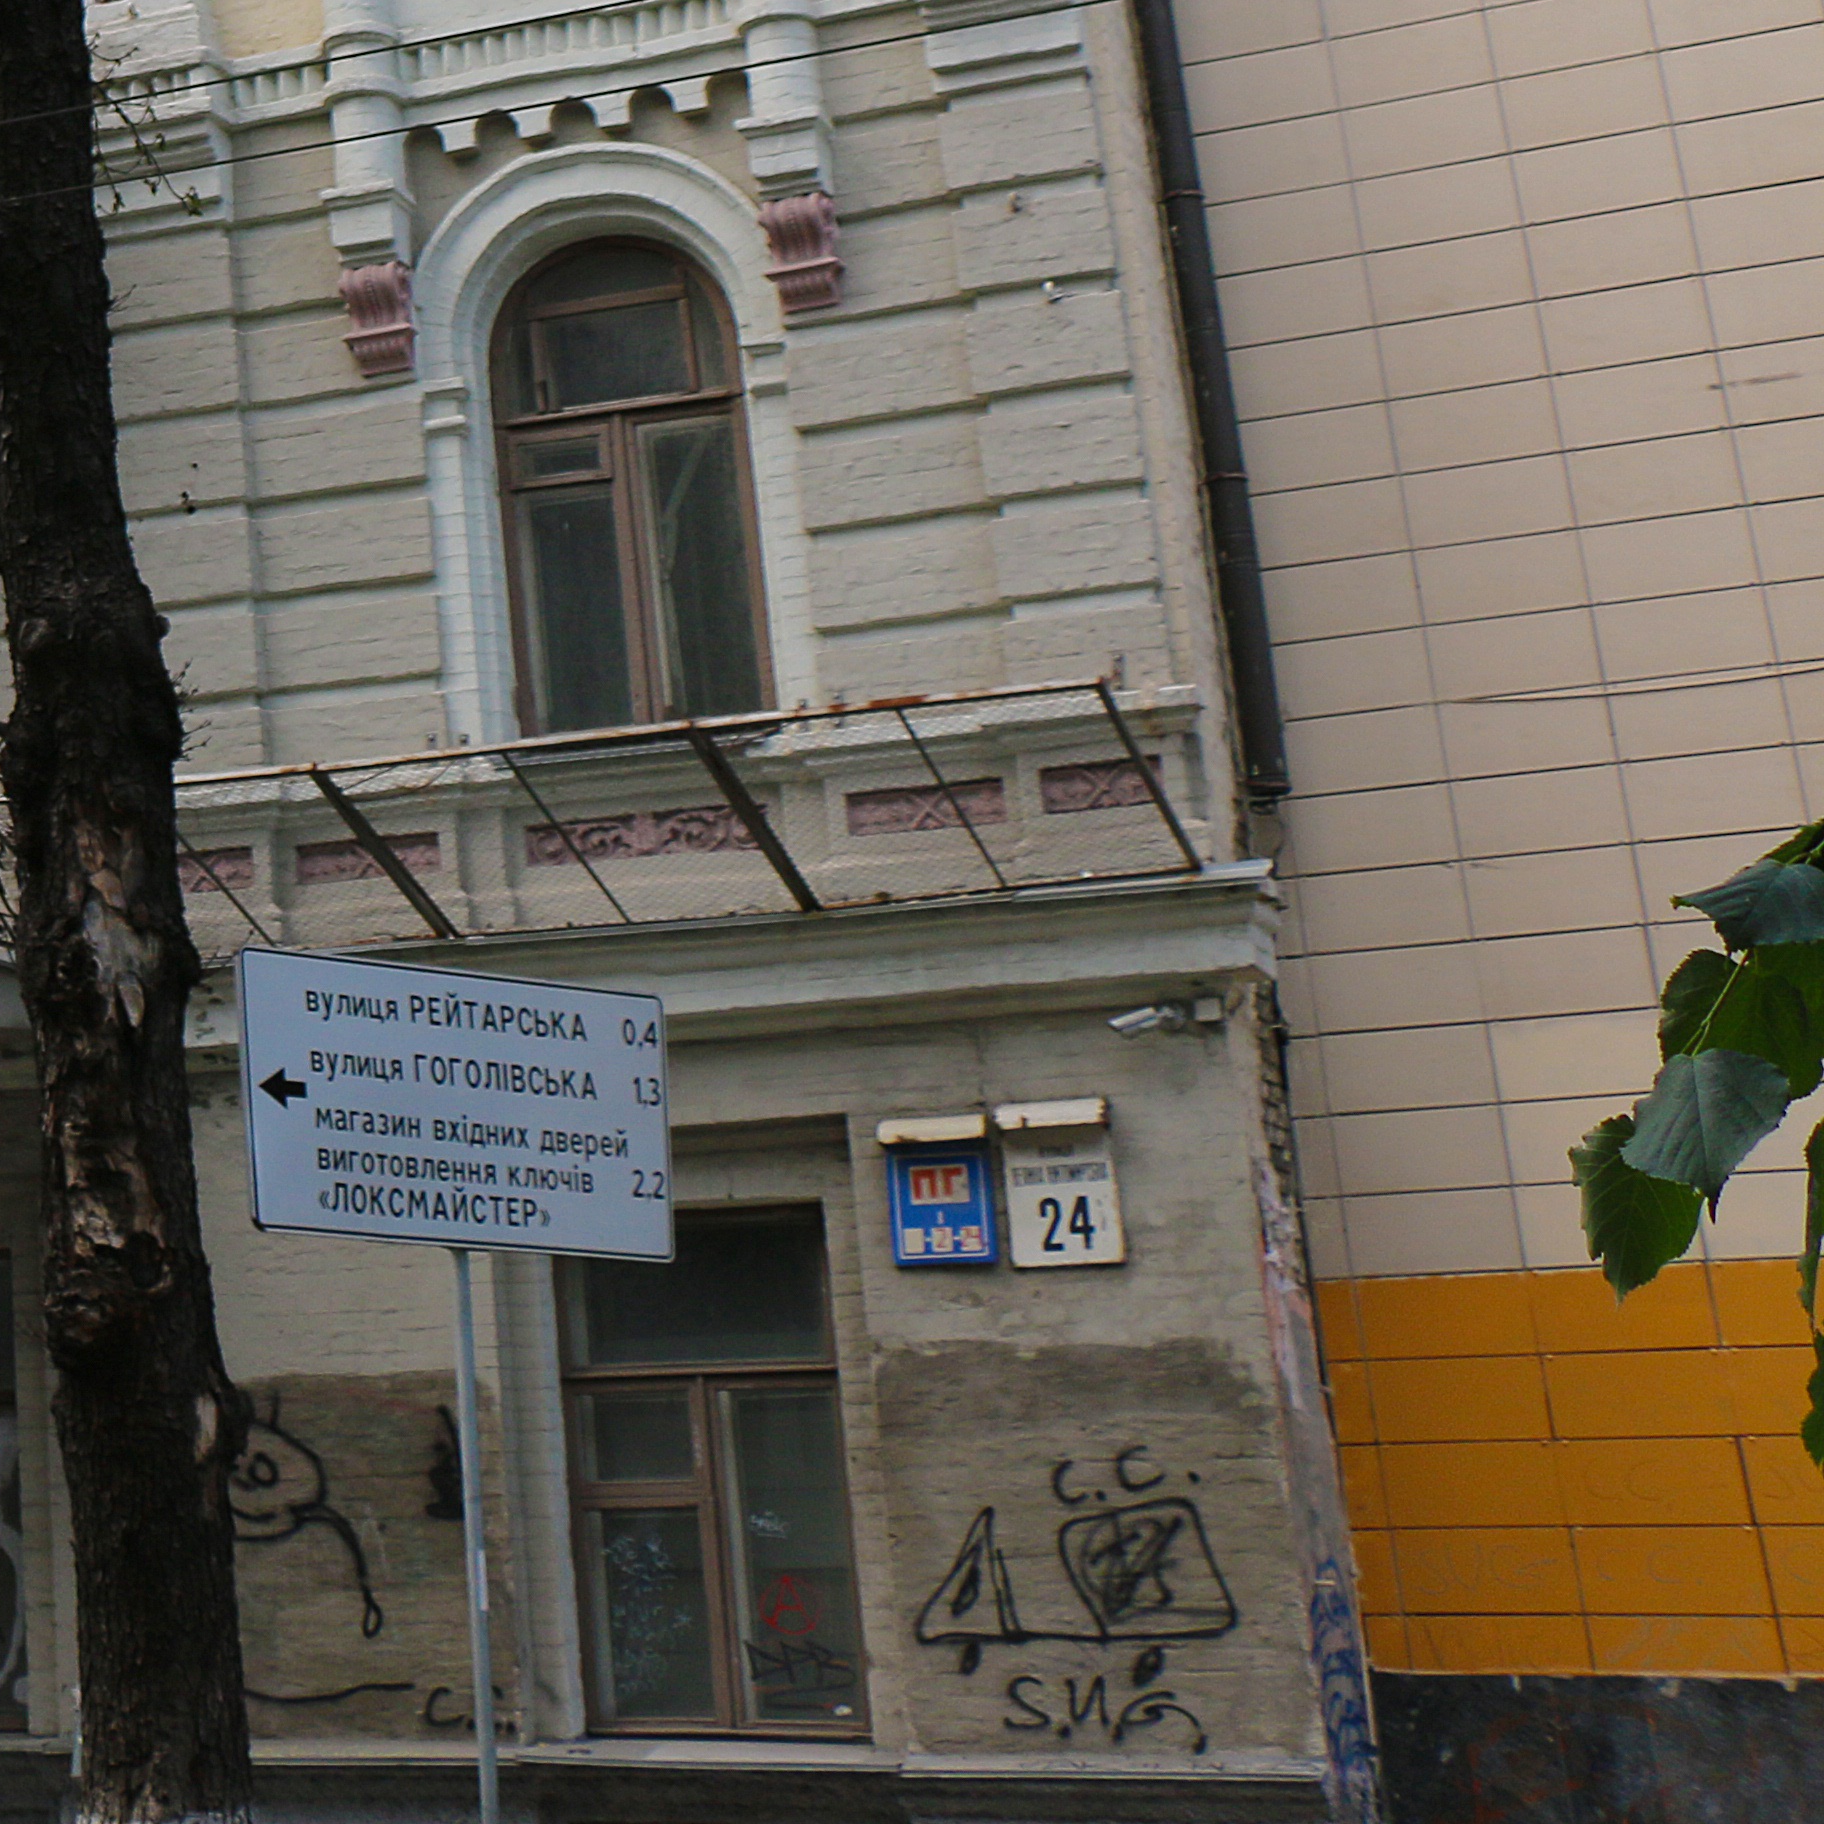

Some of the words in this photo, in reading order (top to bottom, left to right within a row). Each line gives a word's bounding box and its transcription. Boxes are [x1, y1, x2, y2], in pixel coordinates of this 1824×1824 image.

[305, 990, 399, 1024] вулиця
[409, 991, 588, 1042] РЕЙТАРСЬКА
[622, 1018, 658, 1050] 0,4
[310, 1050, 404, 1084] вулиця
[413, 1054, 598, 1100] ГОГОЛІВСЬКА
[315, 1106, 421, 1139] магазин
[432, 1113, 531, 1150] вхідних
[540, 1127, 629, 1162] дверей
[317, 1148, 497, 1186] виготовлення
[507, 1164, 595, 1194] ключів
[318, 1181, 552, 1229] «ЛОКСМАЙСТЕР»
[1039, 1195, 1095, 1252] 24
